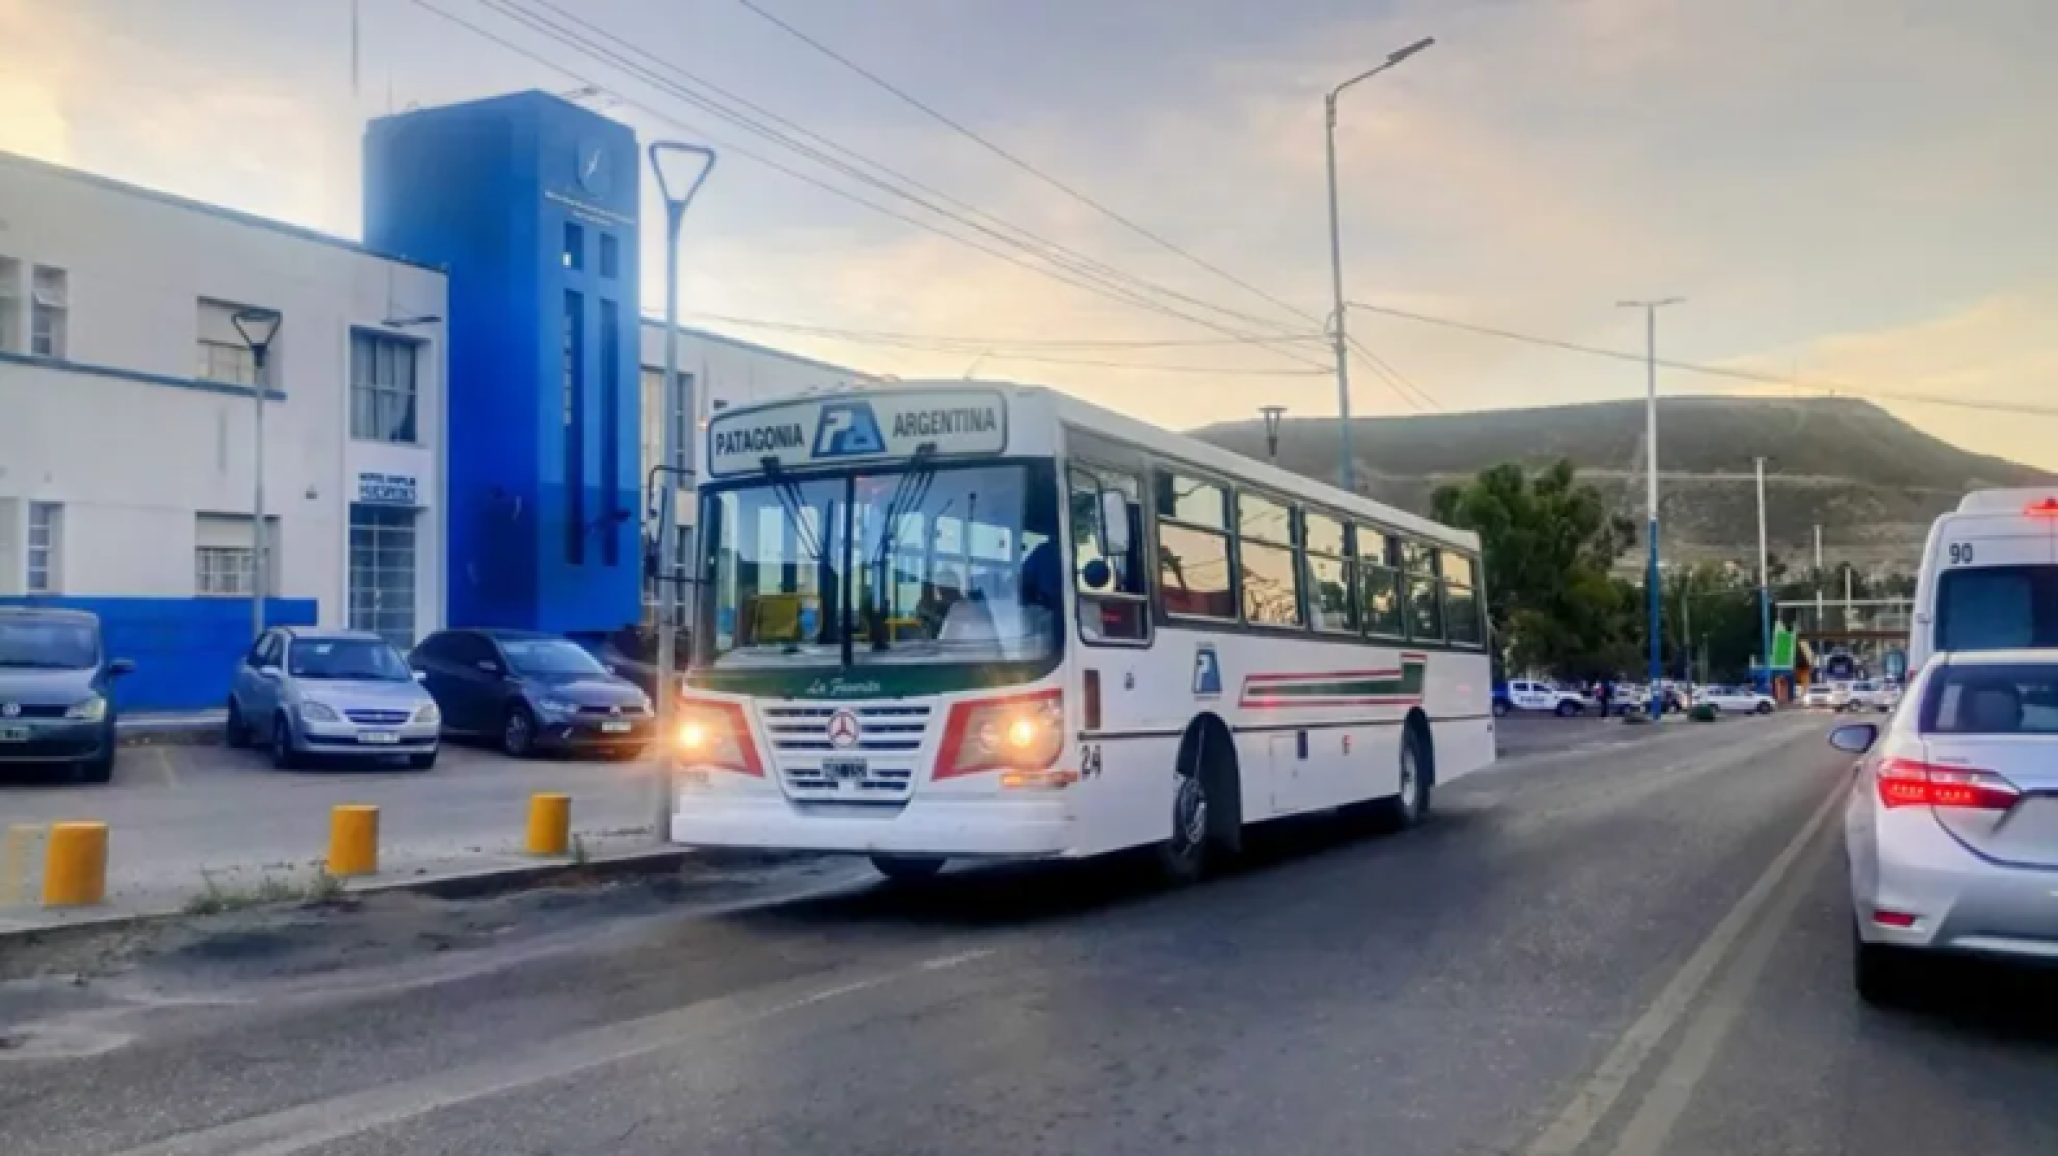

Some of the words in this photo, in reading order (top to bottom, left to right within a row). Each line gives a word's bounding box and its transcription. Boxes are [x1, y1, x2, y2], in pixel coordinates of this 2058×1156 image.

[715, 422, 804, 455] PATAGONIA
[893, 408, 997, 437] ARGENTINA
[1949, 542, 1973, 565] 90
[1081, 745, 1102, 779] 24
